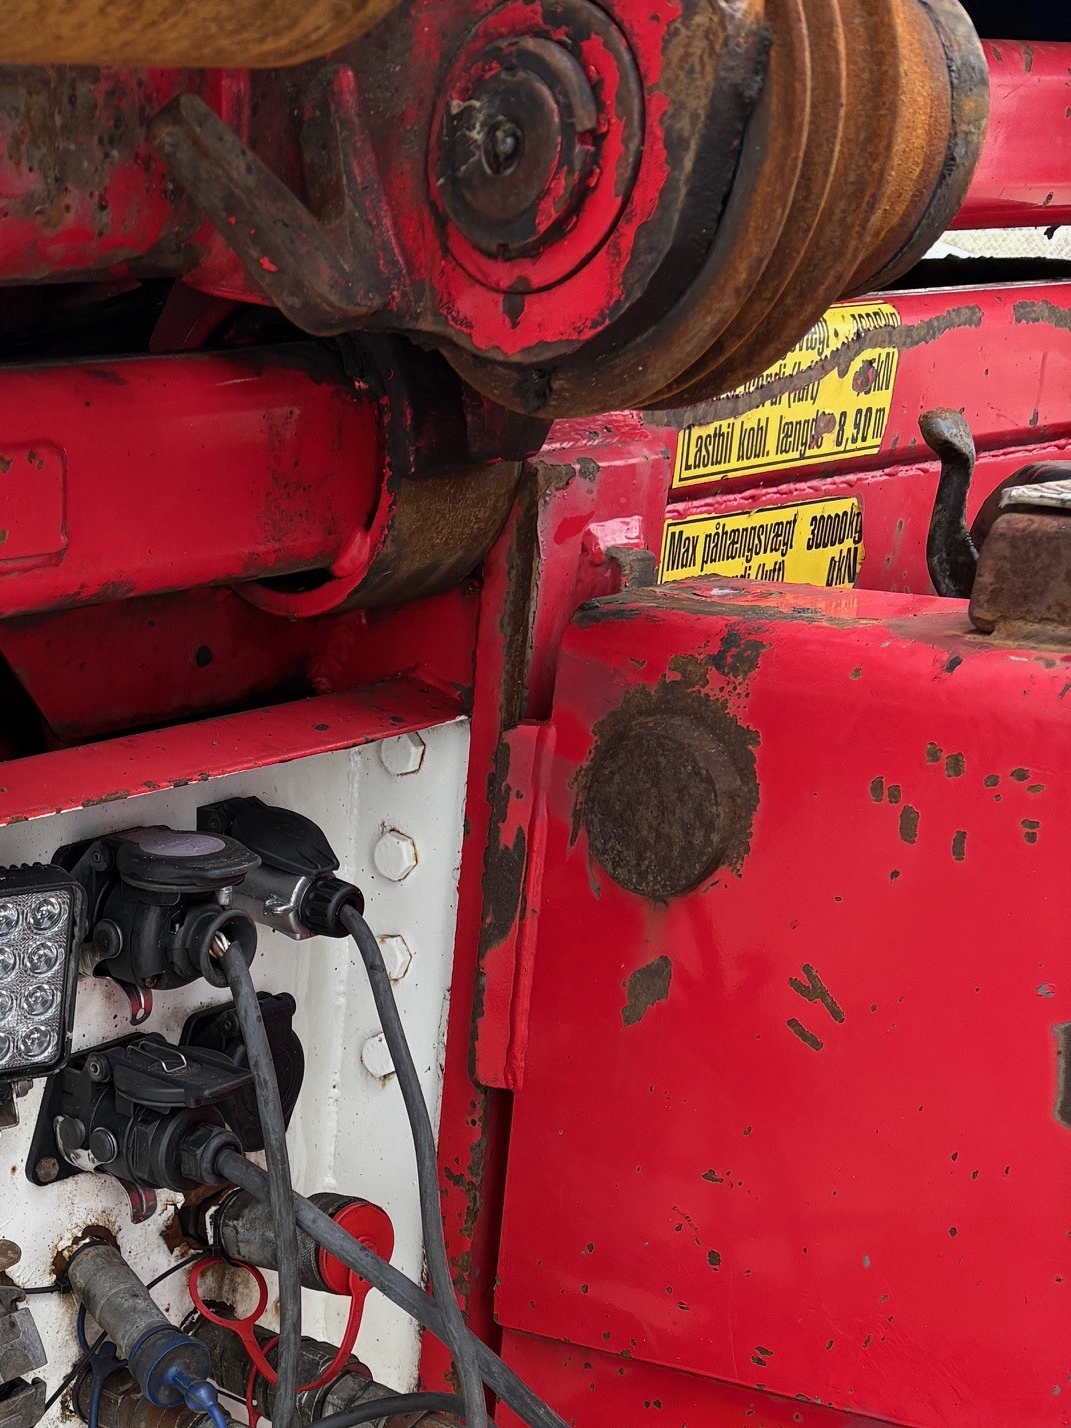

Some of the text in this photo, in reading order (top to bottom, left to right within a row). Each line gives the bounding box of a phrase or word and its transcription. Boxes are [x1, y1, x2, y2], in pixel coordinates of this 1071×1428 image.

[684, 422, 735, 471] Lastbil
[737, 416, 770, 462] kobl.
[666, 502, 863, 573] Max påhængsvægt 30000kg
